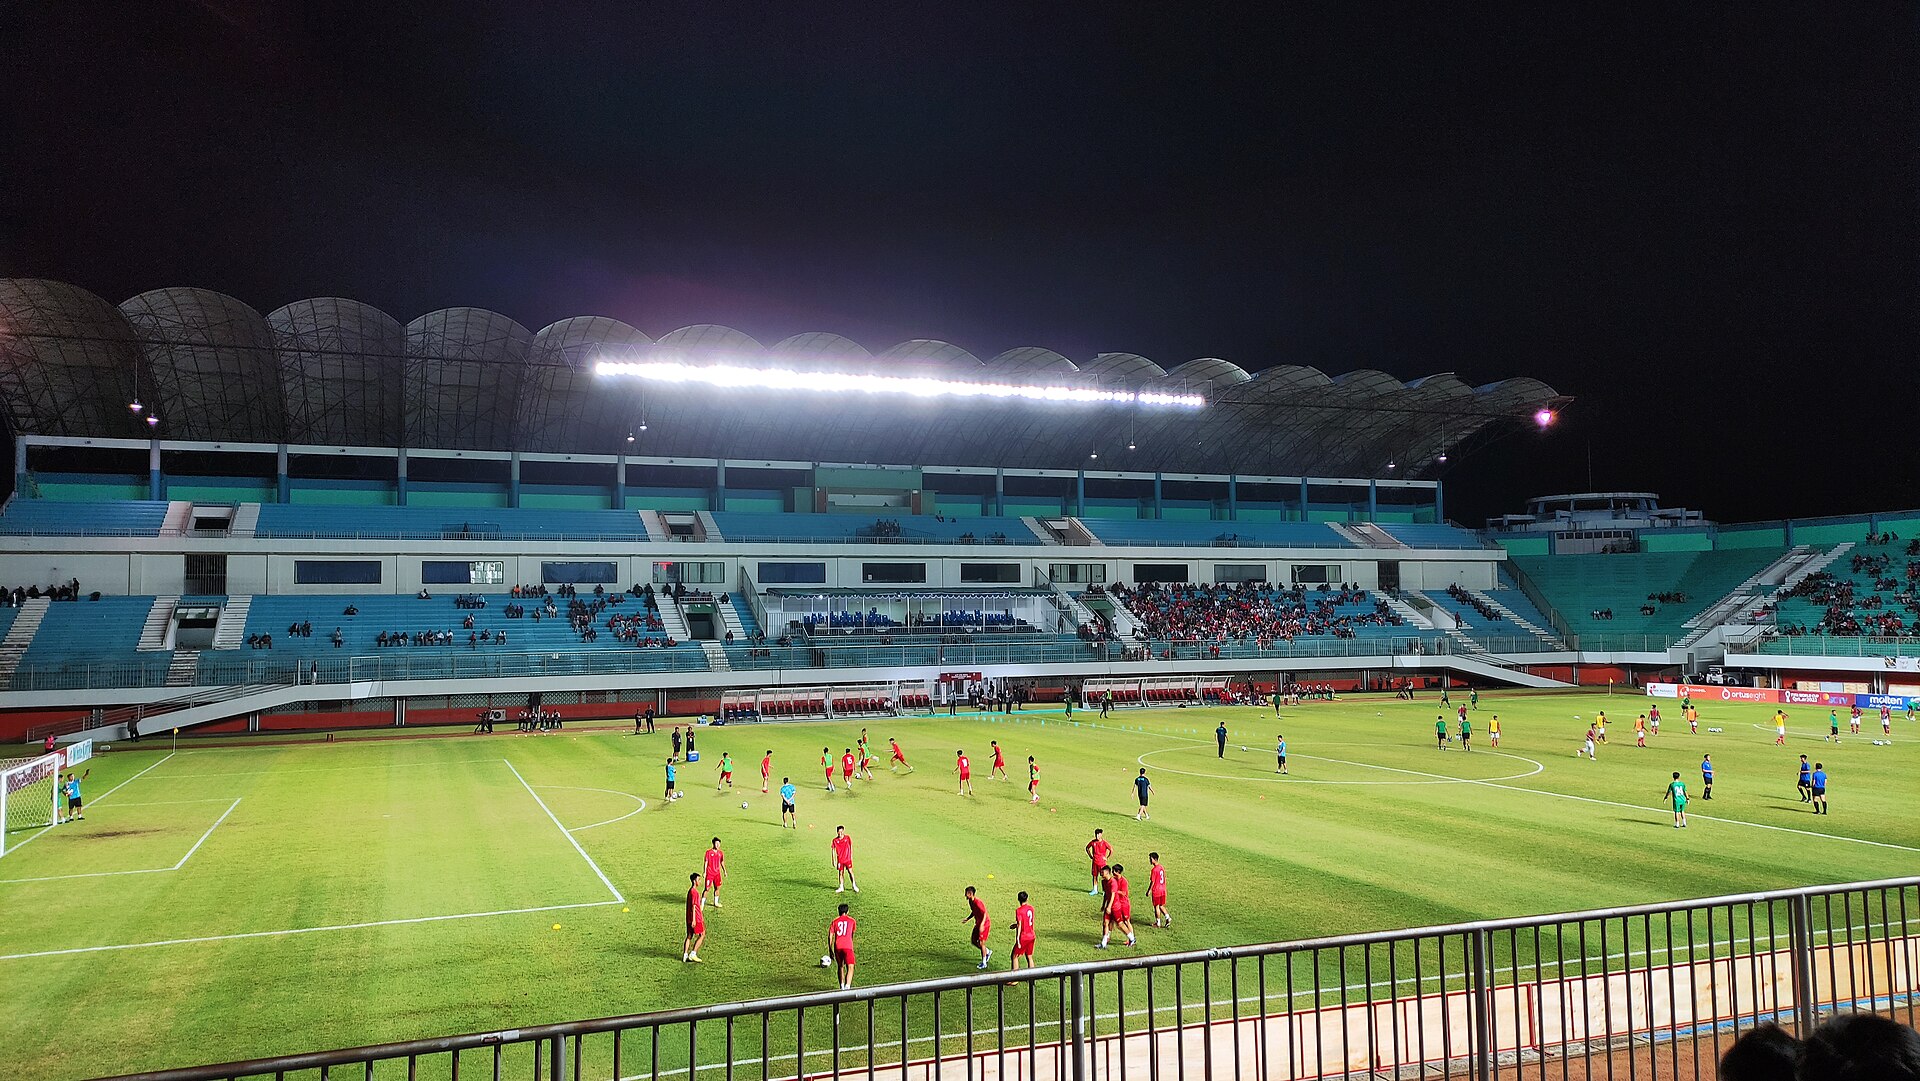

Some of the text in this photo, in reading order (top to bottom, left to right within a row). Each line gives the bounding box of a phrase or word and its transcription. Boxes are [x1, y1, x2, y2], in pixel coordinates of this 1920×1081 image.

[1732, 692, 1766, 701] ortuseight
[1870, 696, 1902, 704] molten
[837, 920, 848, 936] 31
